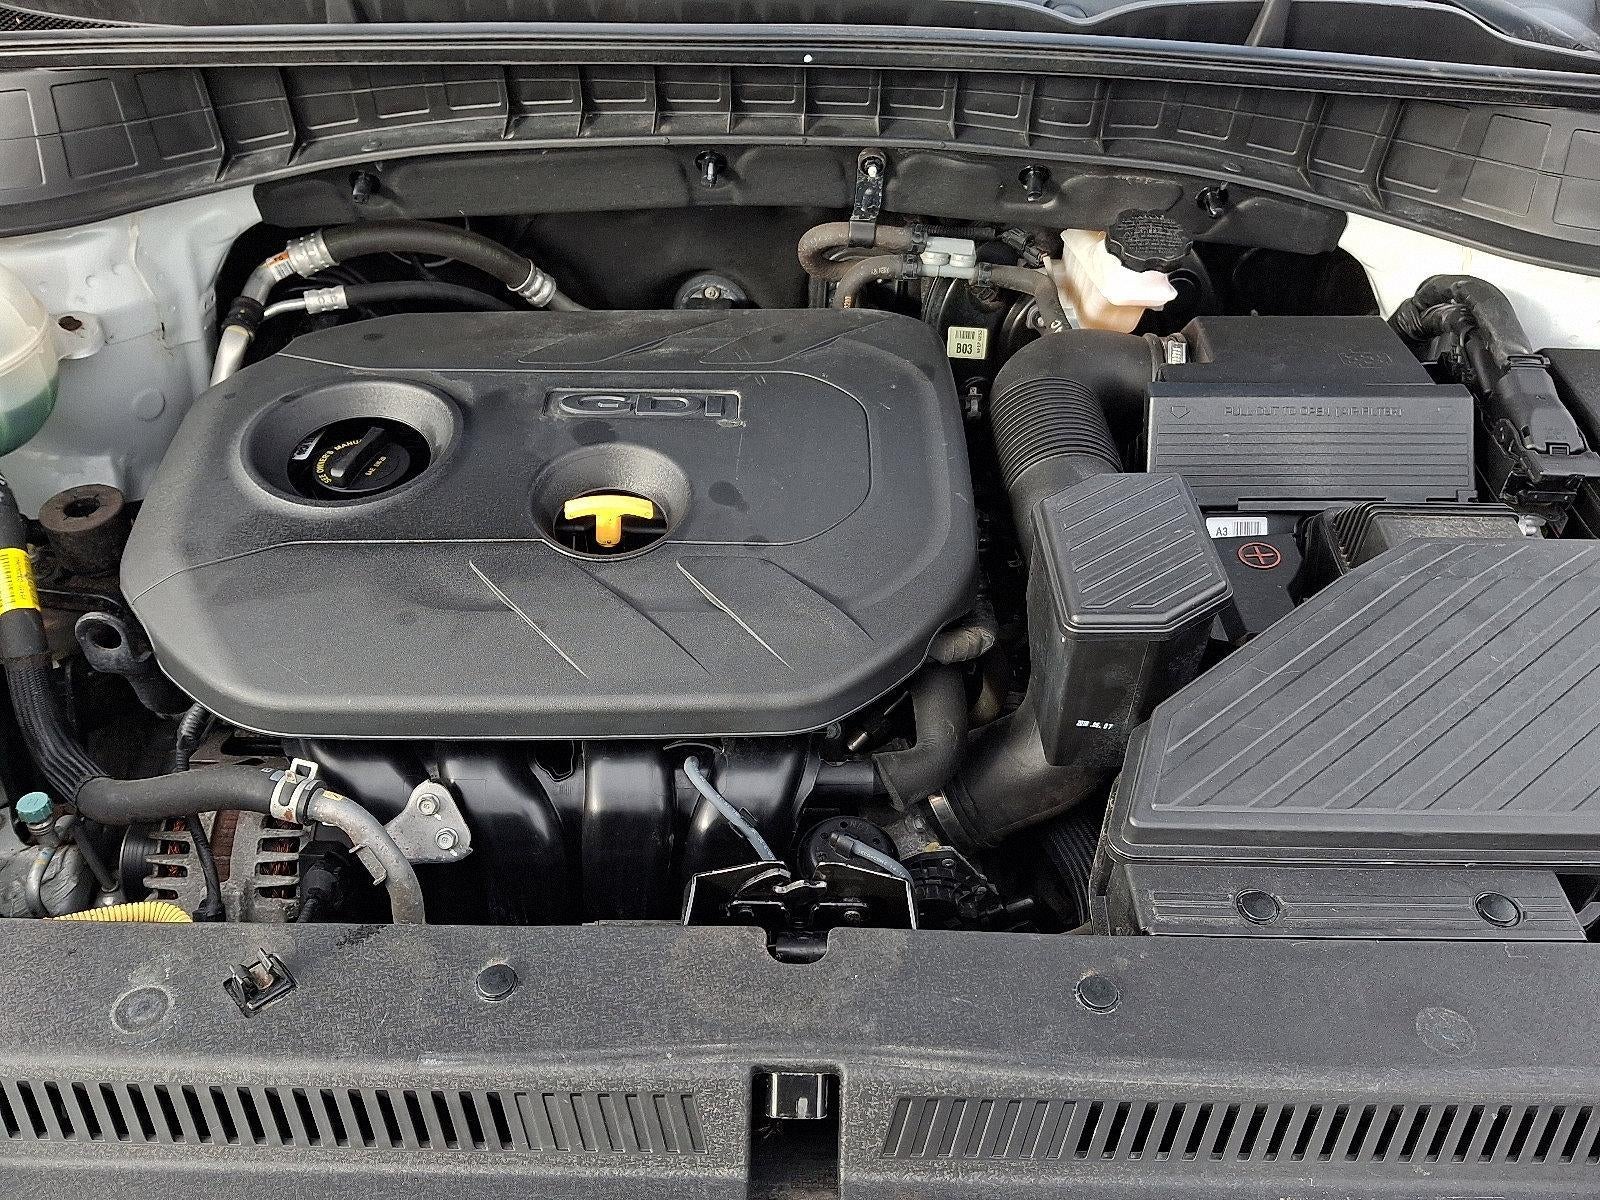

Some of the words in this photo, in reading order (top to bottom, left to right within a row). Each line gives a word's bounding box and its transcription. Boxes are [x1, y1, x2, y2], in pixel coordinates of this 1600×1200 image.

[956, 342, 973, 355] B03
[558, 392, 726, 417] GDI
[1224, 406, 1253, 417] PULL
[1256, 406, 1279, 416] OUT
[333, 439, 362, 451] MANU
[1215, 526, 1228, 537] A3
